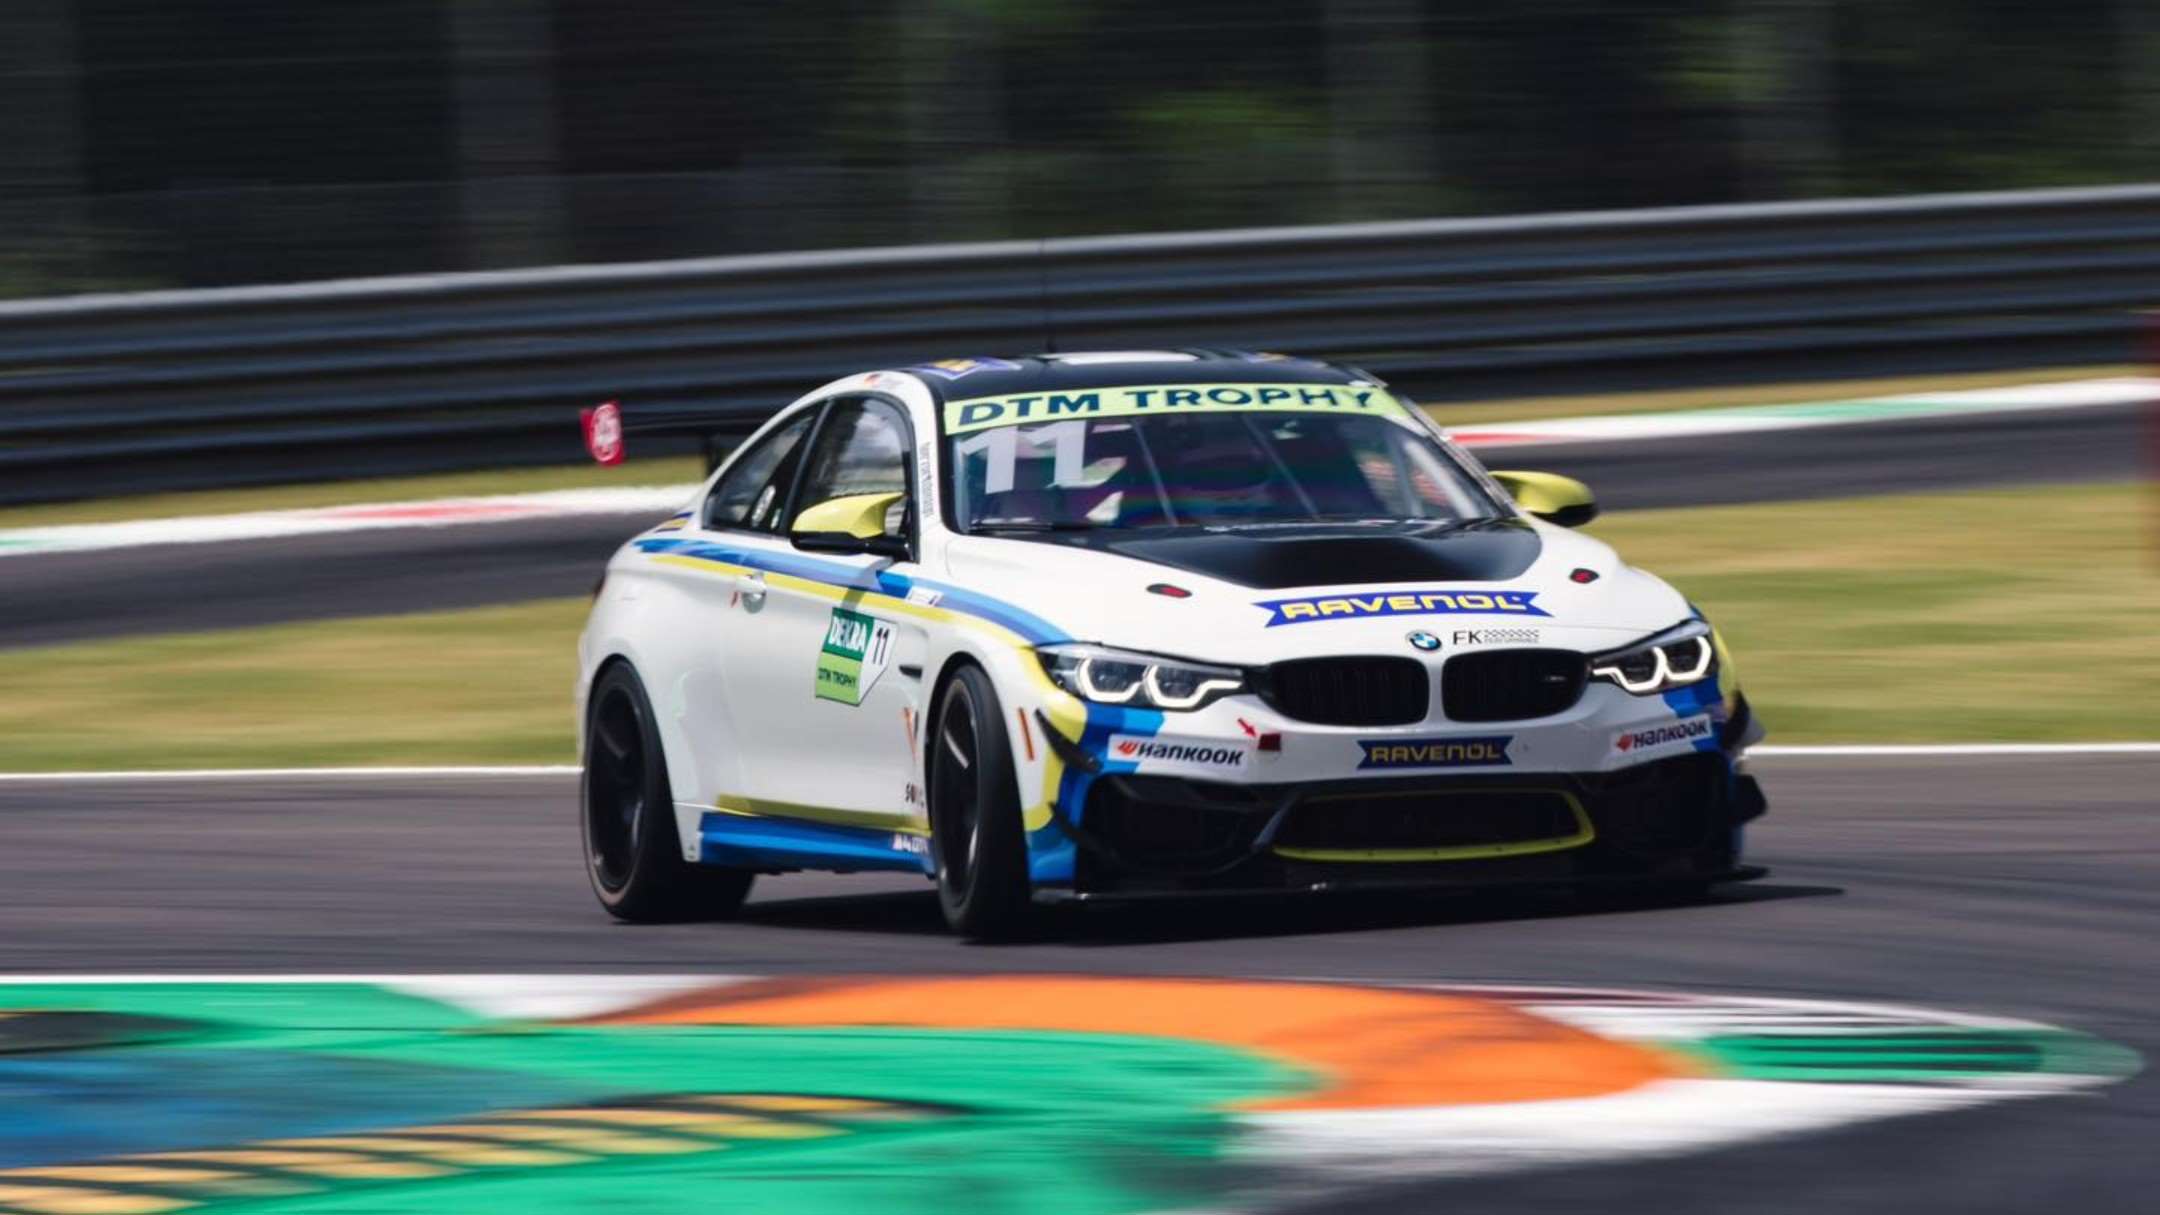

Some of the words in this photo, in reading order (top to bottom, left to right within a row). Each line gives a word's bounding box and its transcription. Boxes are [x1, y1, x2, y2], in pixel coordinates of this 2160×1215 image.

[959, 394, 1099, 425] DTM
[1124, 386, 1374, 410] TROPHY
[960, 420, 1087, 494] 11
[1280, 595, 1526, 618] RAVENOL
[828, 616, 867, 652] DEKRA
[873, 627, 889, 665] 11
[1453, 630, 1482, 645] FK
[1372, 744, 1501, 761] RAVENOL
